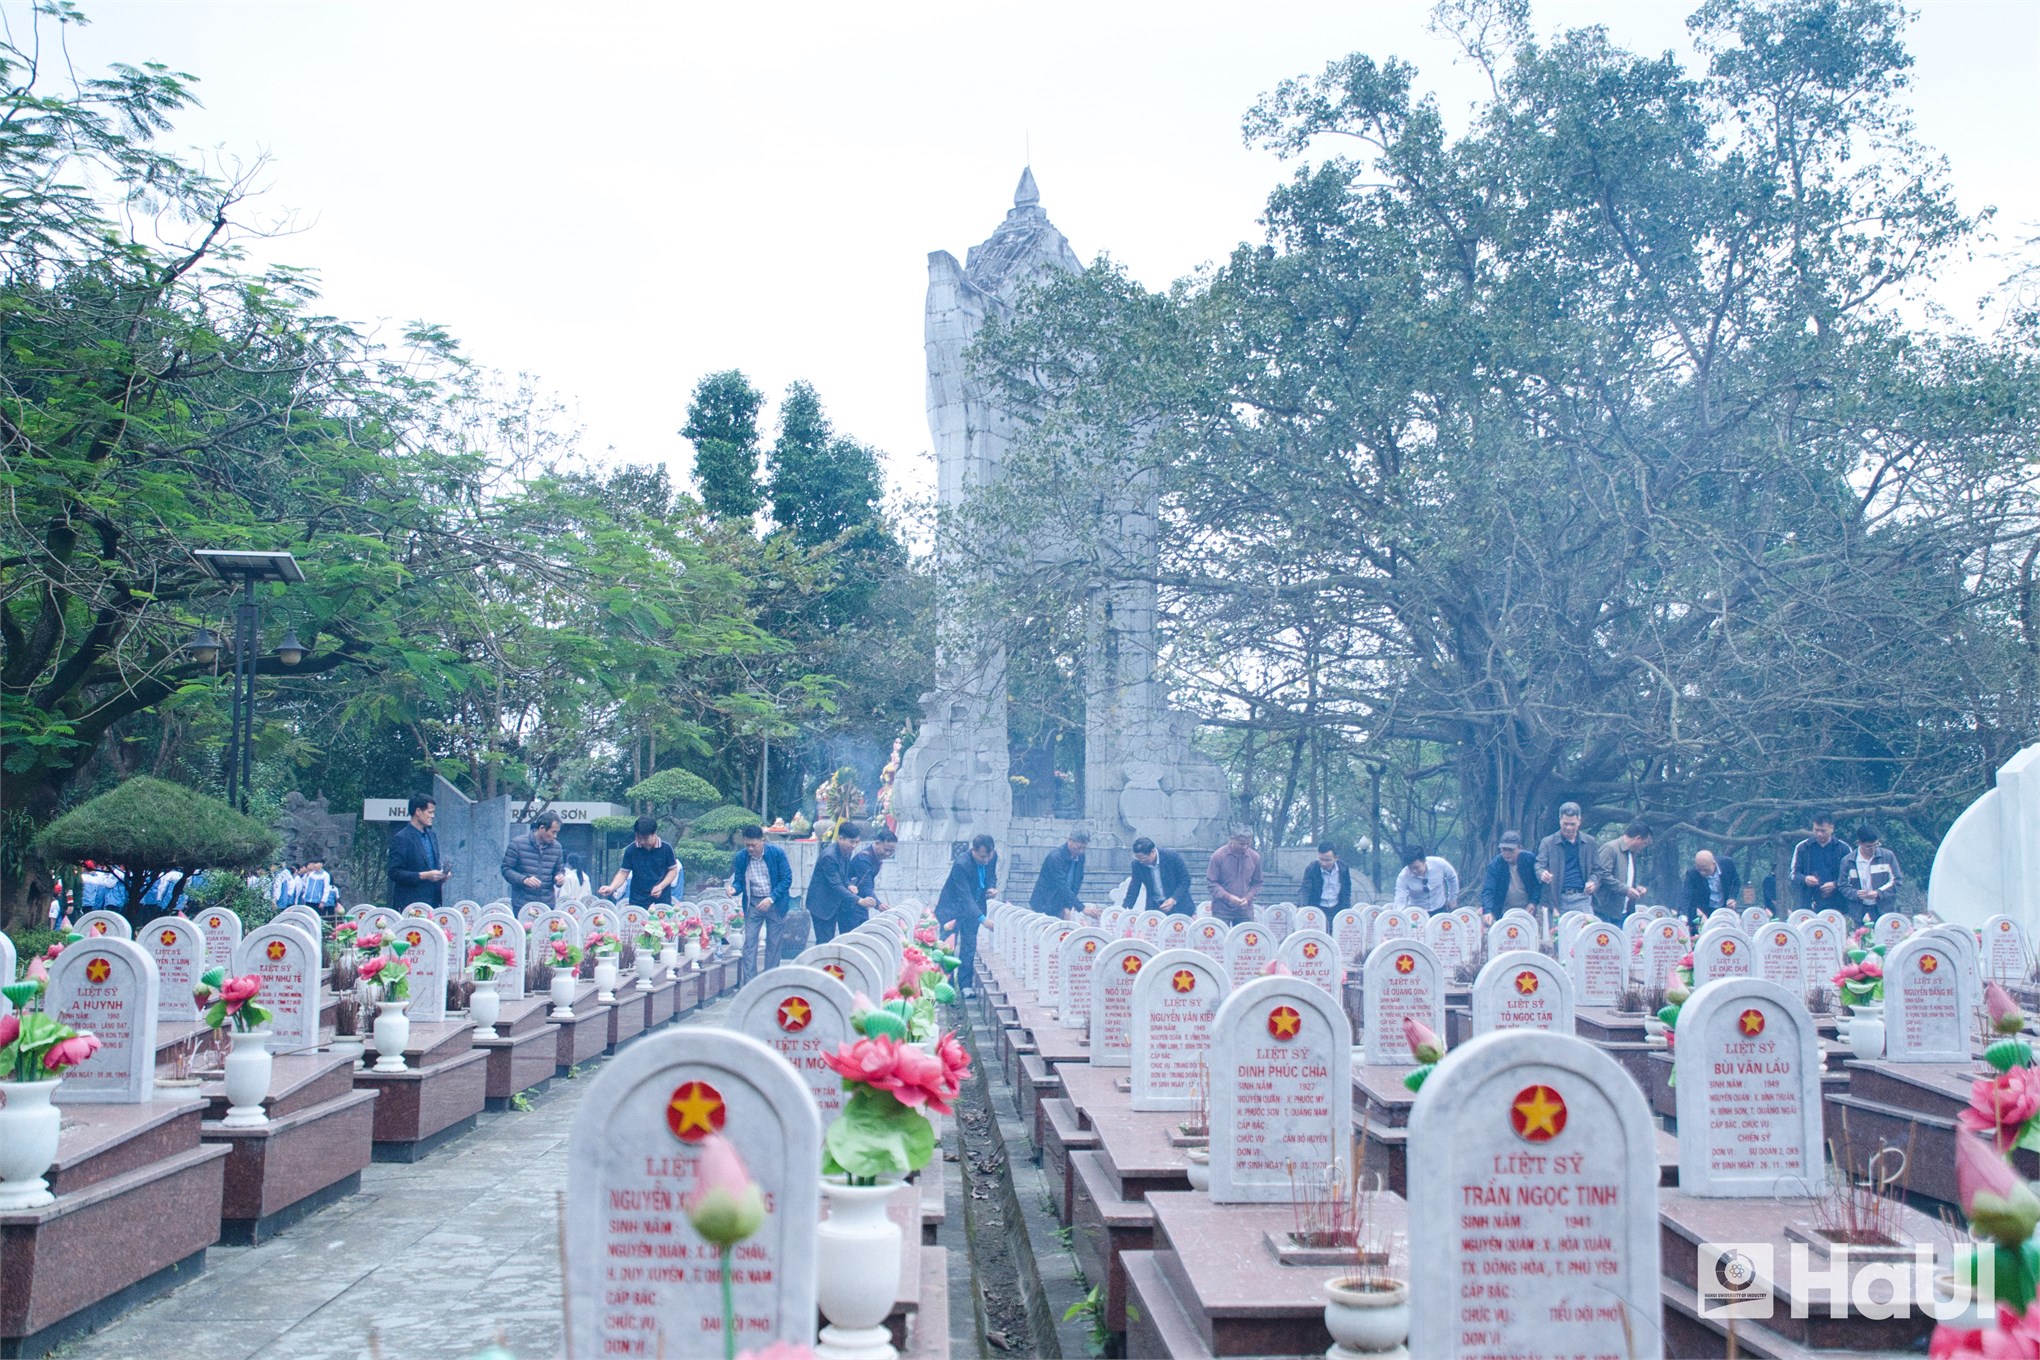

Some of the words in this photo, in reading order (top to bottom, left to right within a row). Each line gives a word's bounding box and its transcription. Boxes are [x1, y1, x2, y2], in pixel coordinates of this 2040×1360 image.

[561, 808, 587, 820] SƠN
[77, 985, 102, 999] LIỆT
[1391, 988, 1412, 996] QUANG
[71, 1001, 80, 1011] A
[83, 1001, 123, 1011] HUYNH
[1164, 996, 1188, 1008] LIỆT
[1507, 998, 1530, 1010] LIỆT
[1531, 998, 1545, 1009] SỸ
[1150, 1008, 1180, 1022] NGUYỄN
[1182, 1010, 1198, 1022] VĂN
[1513, 1012, 1535, 1025] NGỌC
[802, 1036, 821, 1051] SỸ
[1725, 1040, 1756, 1057] LIỆT
[1758, 1040, 1776, 1054] SỸ
[1256, 1045, 1289, 1062] LIỆT
[1291, 1046, 1311, 1060] SỸ
[1238, 1065, 1265, 1078] ĐINH
[1268, 1062, 1298, 1078] PHÚC
[1714, 1059, 1734, 1075] BÙI
[1737, 1060, 1762, 1075] VĂN
[1766, 1057, 1790, 1074] LẦU
[1238, 1082, 1254, 1090] SINH
[1299, 1082, 1316, 1091] 1927
[1709, 1080, 1725, 1088] SINH
[1763, 1080, 1780, 1089] 1949
[1313, 1108, 1328, 1116] NAM
[1237, 1119, 1251, 1130] CẤP
[646, 1153, 701, 1182] LIỆT
[1237, 1161, 1246, 1170] HY
[1247, 1161, 1263, 1170] SINH
[1493, 1151, 1547, 1179] LIỆT
[1553, 1152, 1584, 1175] SỸ
[1712, 1161, 1721, 1170] HY
[1722, 1161, 1736, 1170] SINH
[609, 1179, 672, 1212] NGUYỄN
[1461, 1178, 1511, 1206] TRẦN
[1517, 1186, 1569, 1213] NGỌC
[1575, 1186, 1618, 1206] TINH
[609, 1219, 638, 1235] SINH
[1461, 1215, 1489, 1229] SINH
[607, 1240, 652, 1259] NGUYÊN
[1461, 1234, 1503, 1251] NGUYÊN
[1595, 1258, 1618, 1276] YÊN
[619, 1267, 643, 1281] DUY
[748, 1270, 773, 1284] NAM
[605, 1289, 630, 1306] CẤP
[1461, 1281, 1483, 1299] CẤP
[1461, 1304, 1491, 1322] CHỨC
